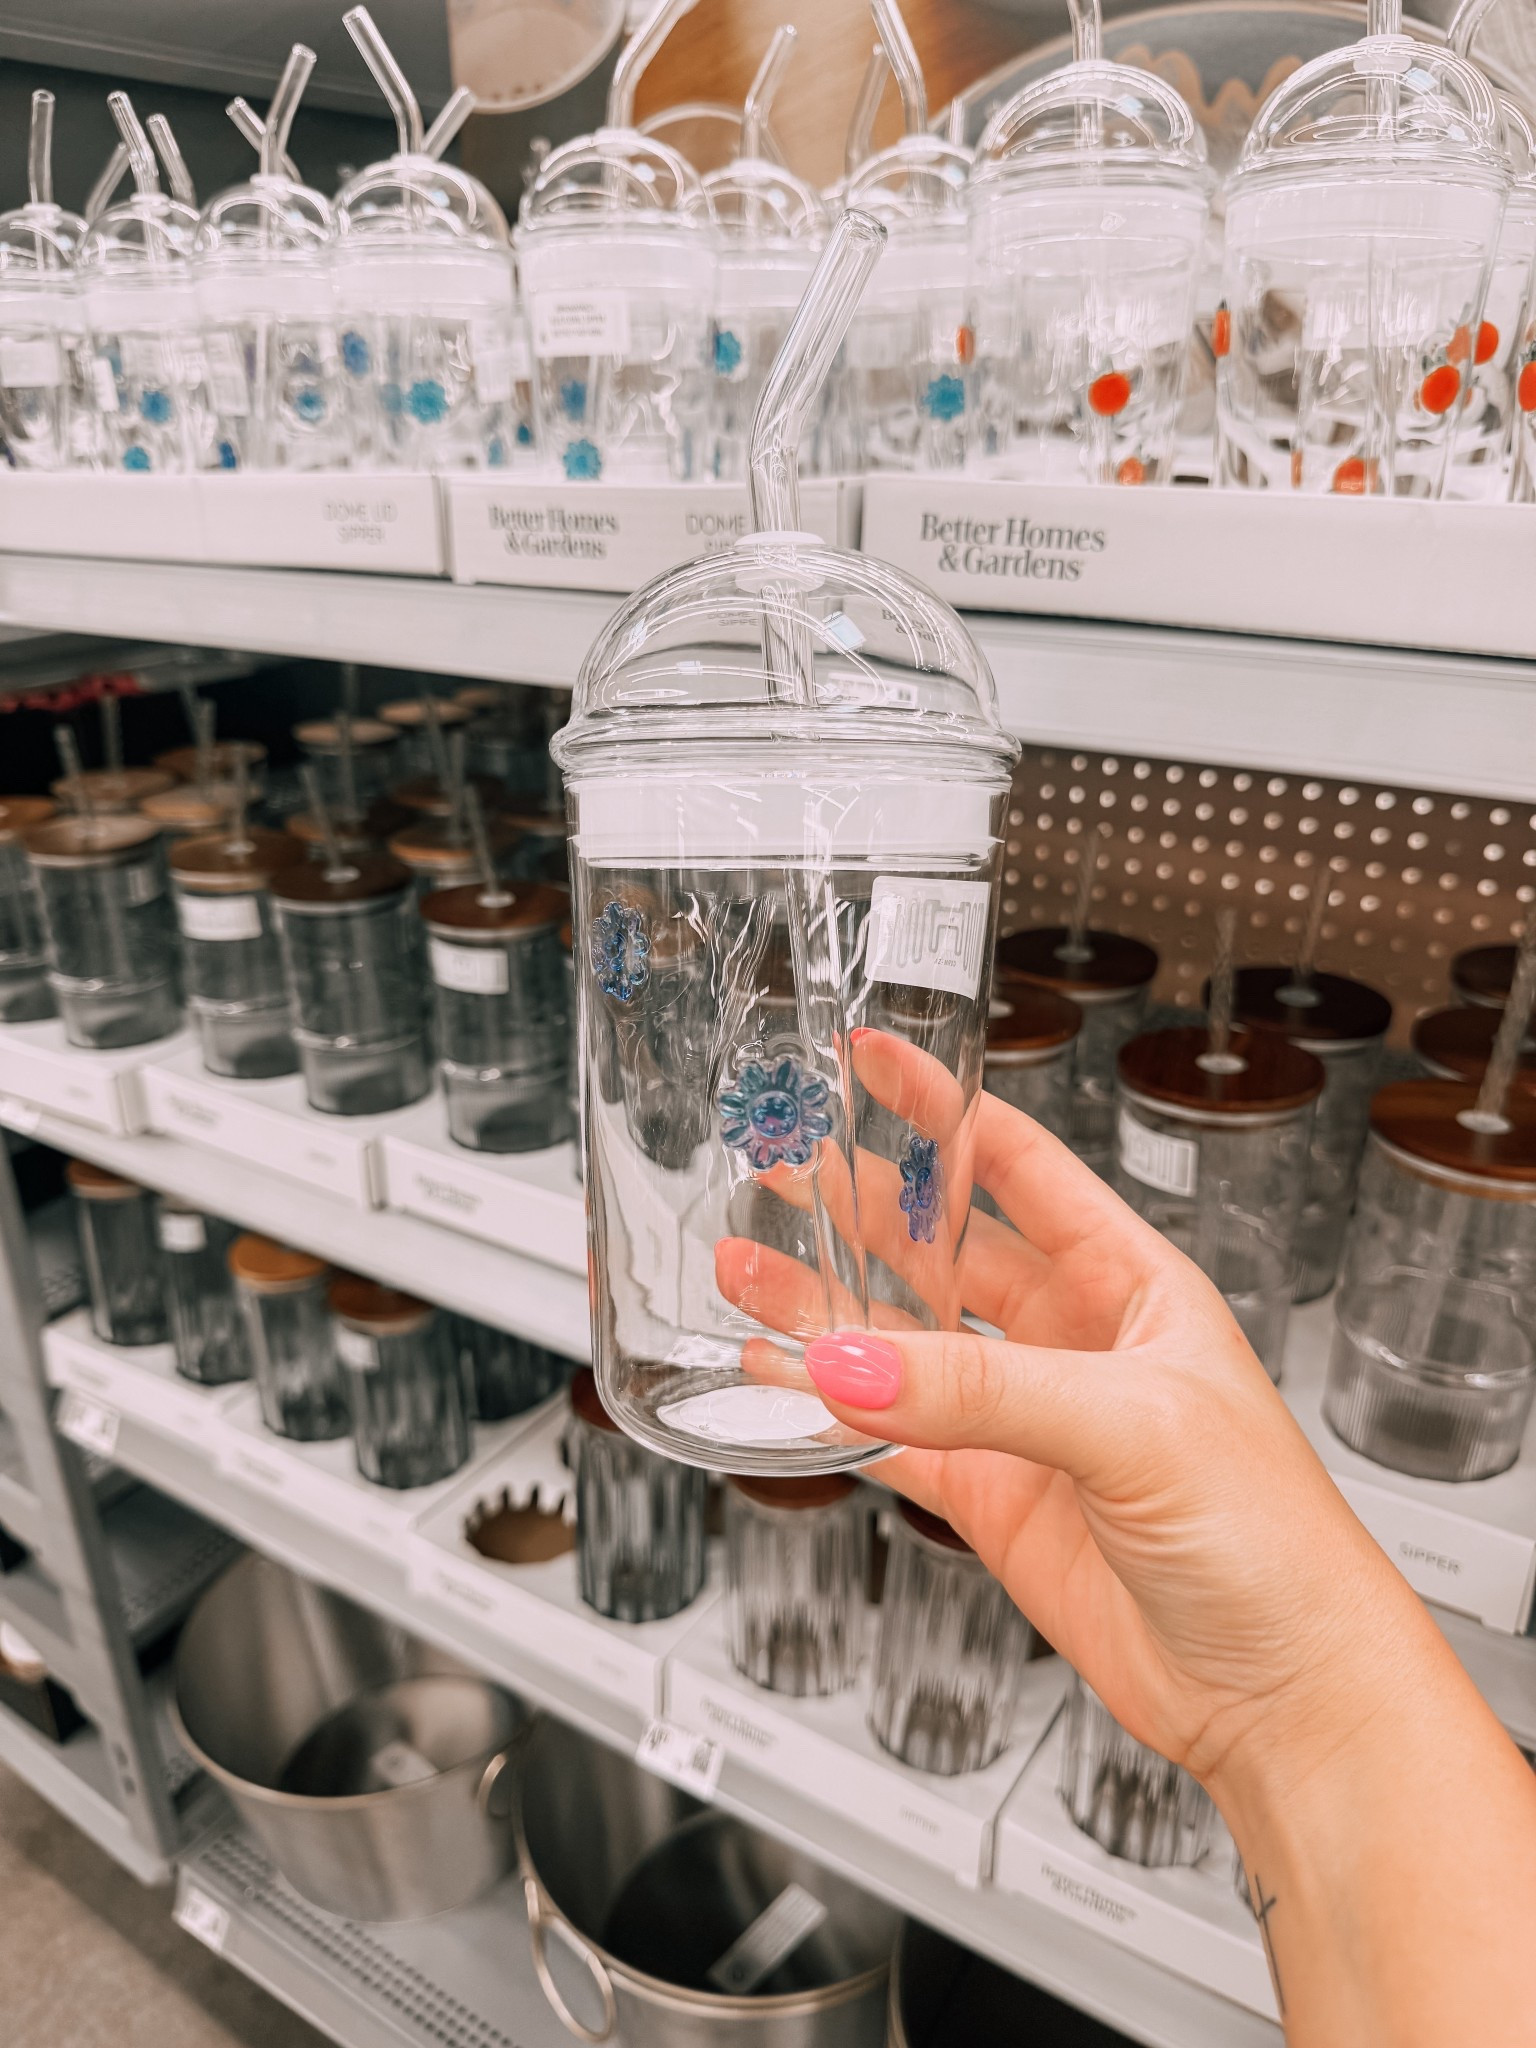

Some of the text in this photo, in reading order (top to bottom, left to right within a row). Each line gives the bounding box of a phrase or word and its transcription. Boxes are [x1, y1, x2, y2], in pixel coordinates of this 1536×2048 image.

[488, 502, 620, 536] Better Homes
[920, 512, 1106, 553] Better Homes
